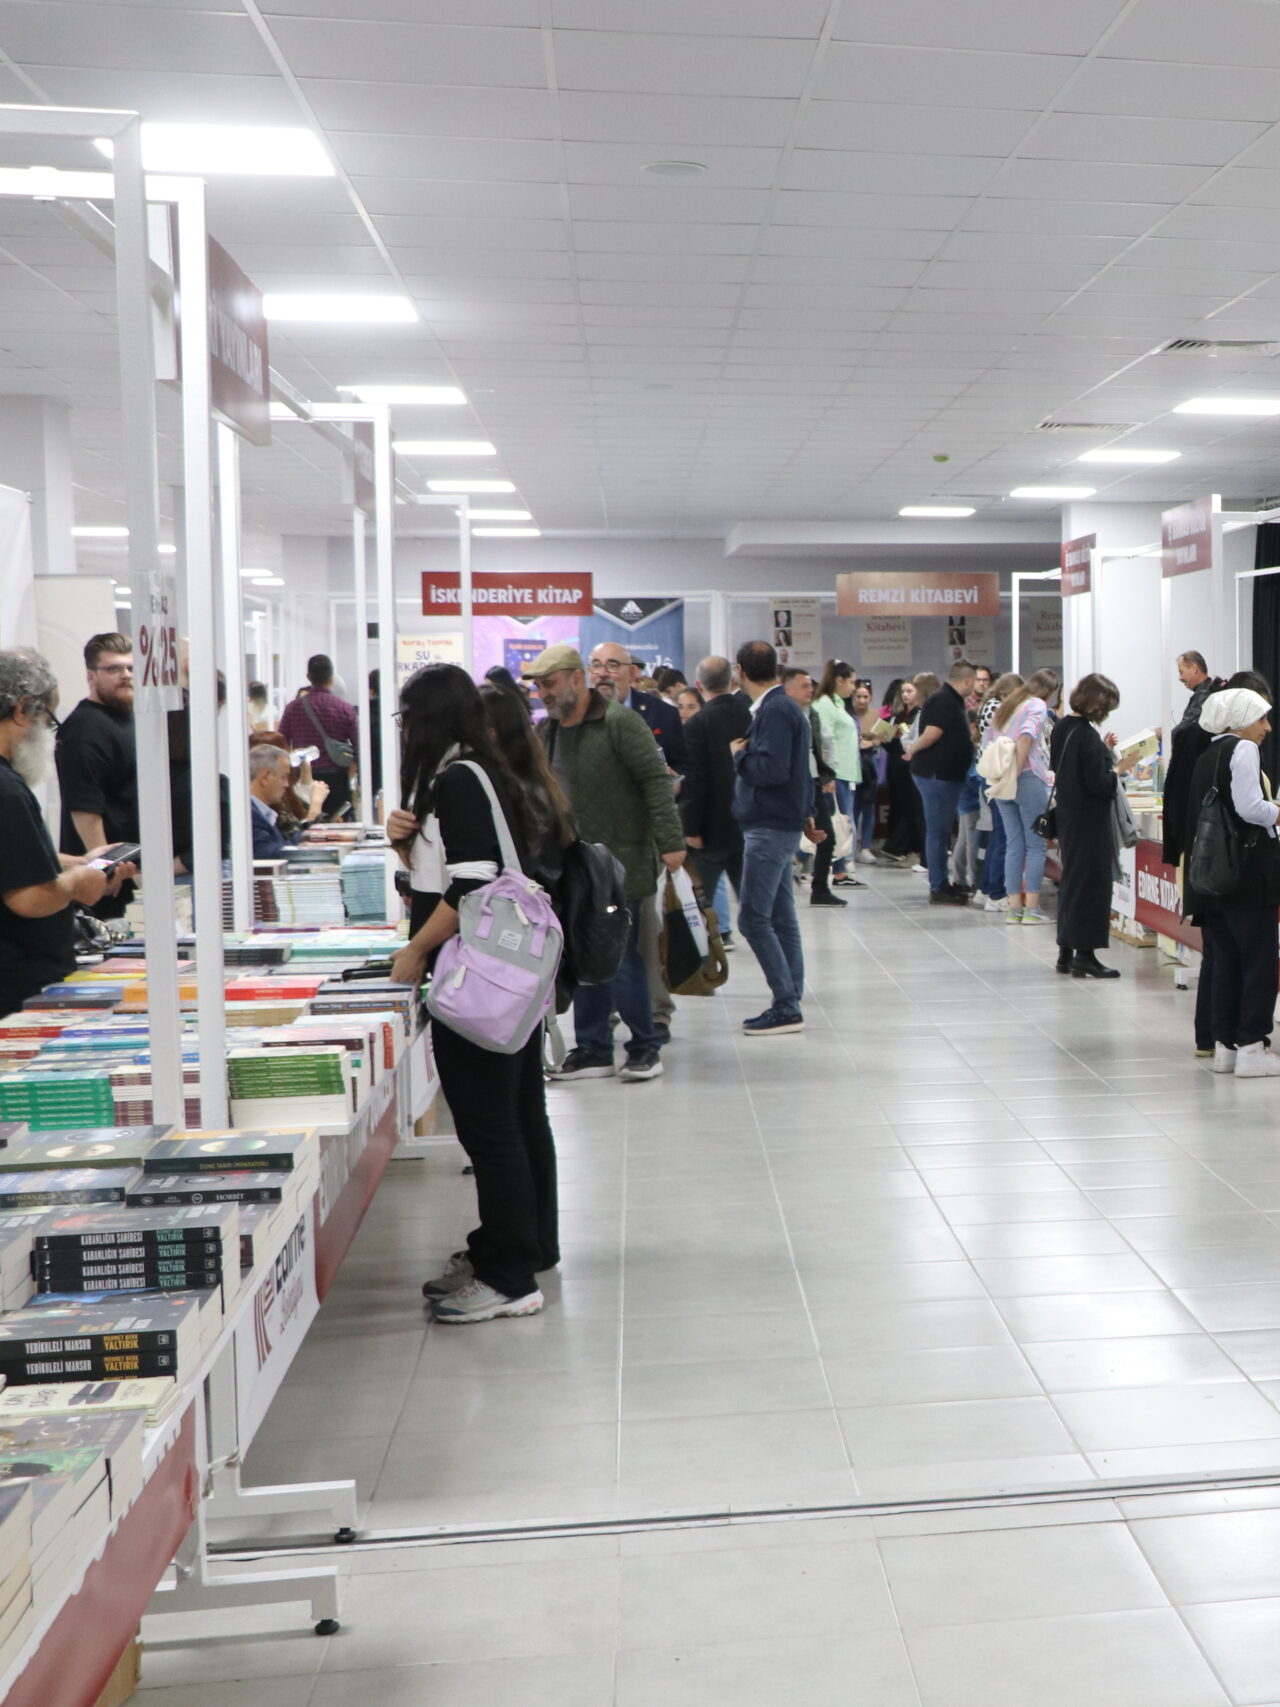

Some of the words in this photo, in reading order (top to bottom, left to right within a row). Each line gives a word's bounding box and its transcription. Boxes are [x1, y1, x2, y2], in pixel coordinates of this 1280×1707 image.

[430, 584, 533, 604] İSKNDERİYE
[537, 584, 583, 604] KİTAP
[858, 585, 905, 604] REMZİ
[910, 585, 979, 605] KİTABEVİ
[140, 625, 178, 687] %25
[415, 650, 431, 661] SU
[1138, 864, 1160, 906] EDİRNE
[64, 1338, 91, 1351] MANSUR
[104, 1339, 139, 1350] YALTIRIK
[65, 1359, 92, 1372] MANSUR
[104, 1360, 139, 1371] YALTIRIK
